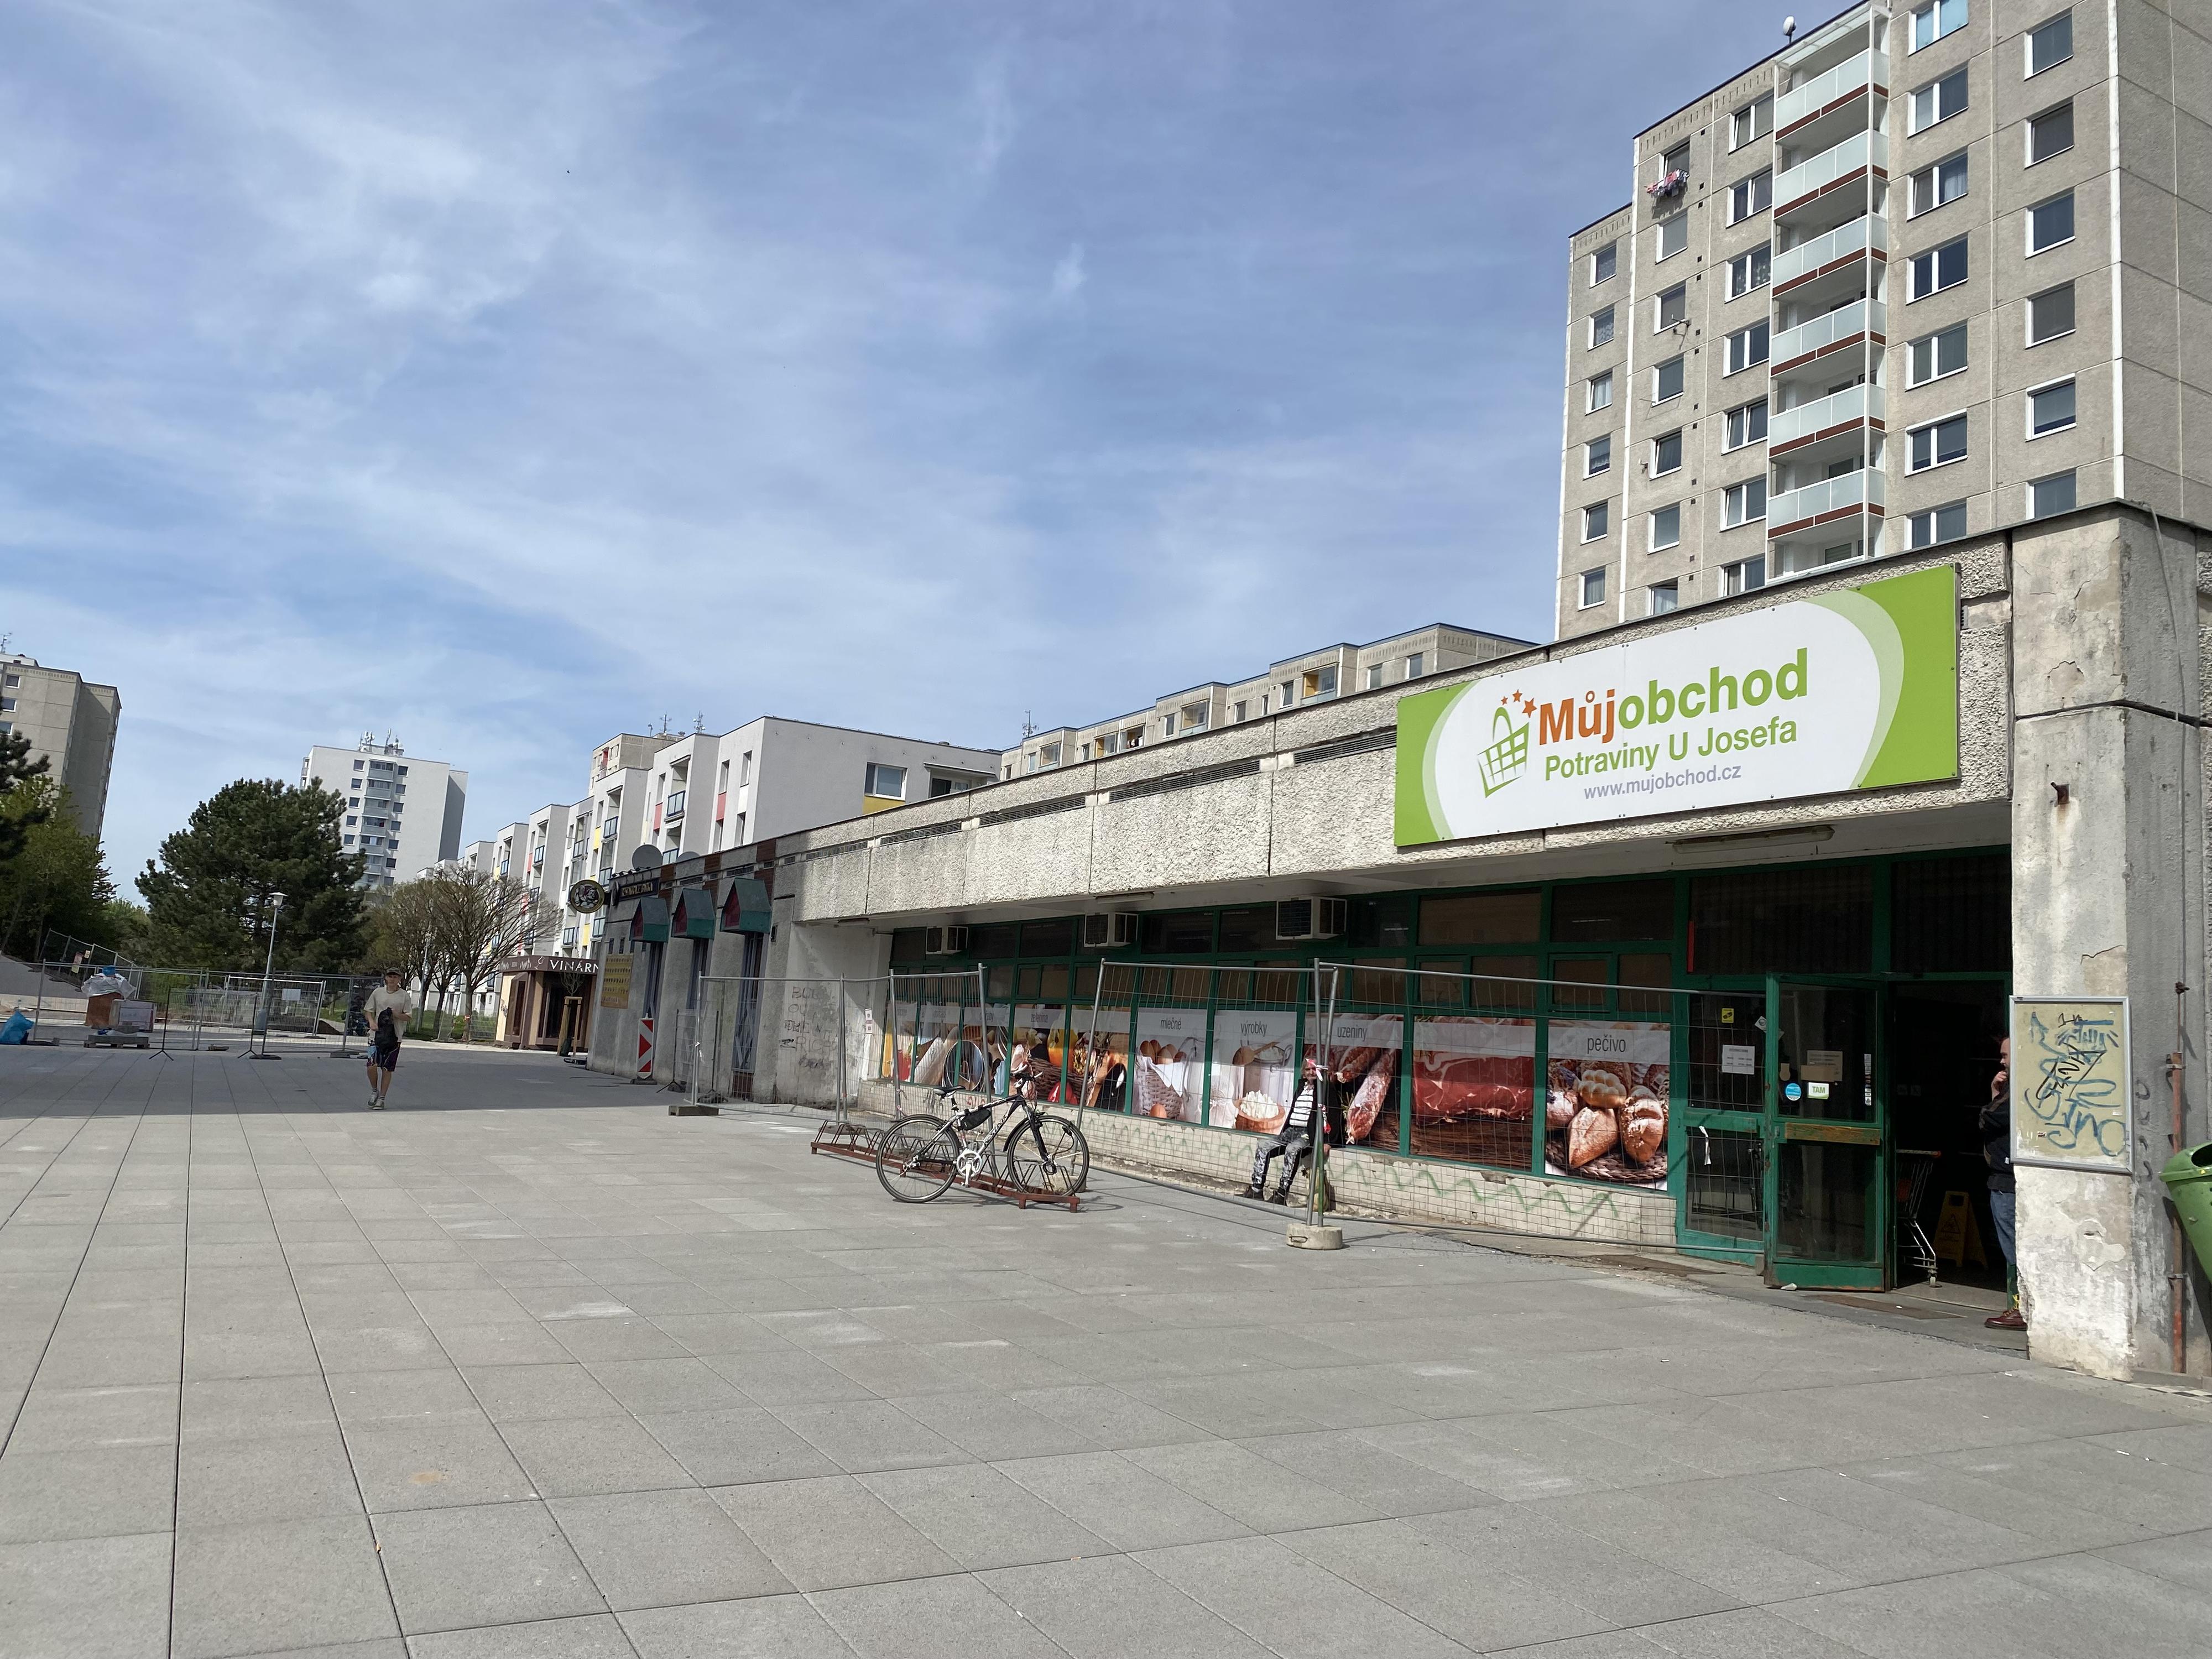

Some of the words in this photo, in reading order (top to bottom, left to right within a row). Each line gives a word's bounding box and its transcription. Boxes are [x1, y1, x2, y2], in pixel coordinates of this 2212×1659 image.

[1539, 648, 1807, 746] Můjobchod
[1546, 744, 1658, 780] Potraviny
[1669, 732, 1688, 760] U
[1698, 717, 1797, 757] Josefa
[1584, 765, 1741, 799] www.mujobchod.cz
[1240, 1020, 1267, 1037] výrobky
[1337, 1024, 1367, 1041] uzeniny
[1587, 1034, 1626, 1054] pečivo
